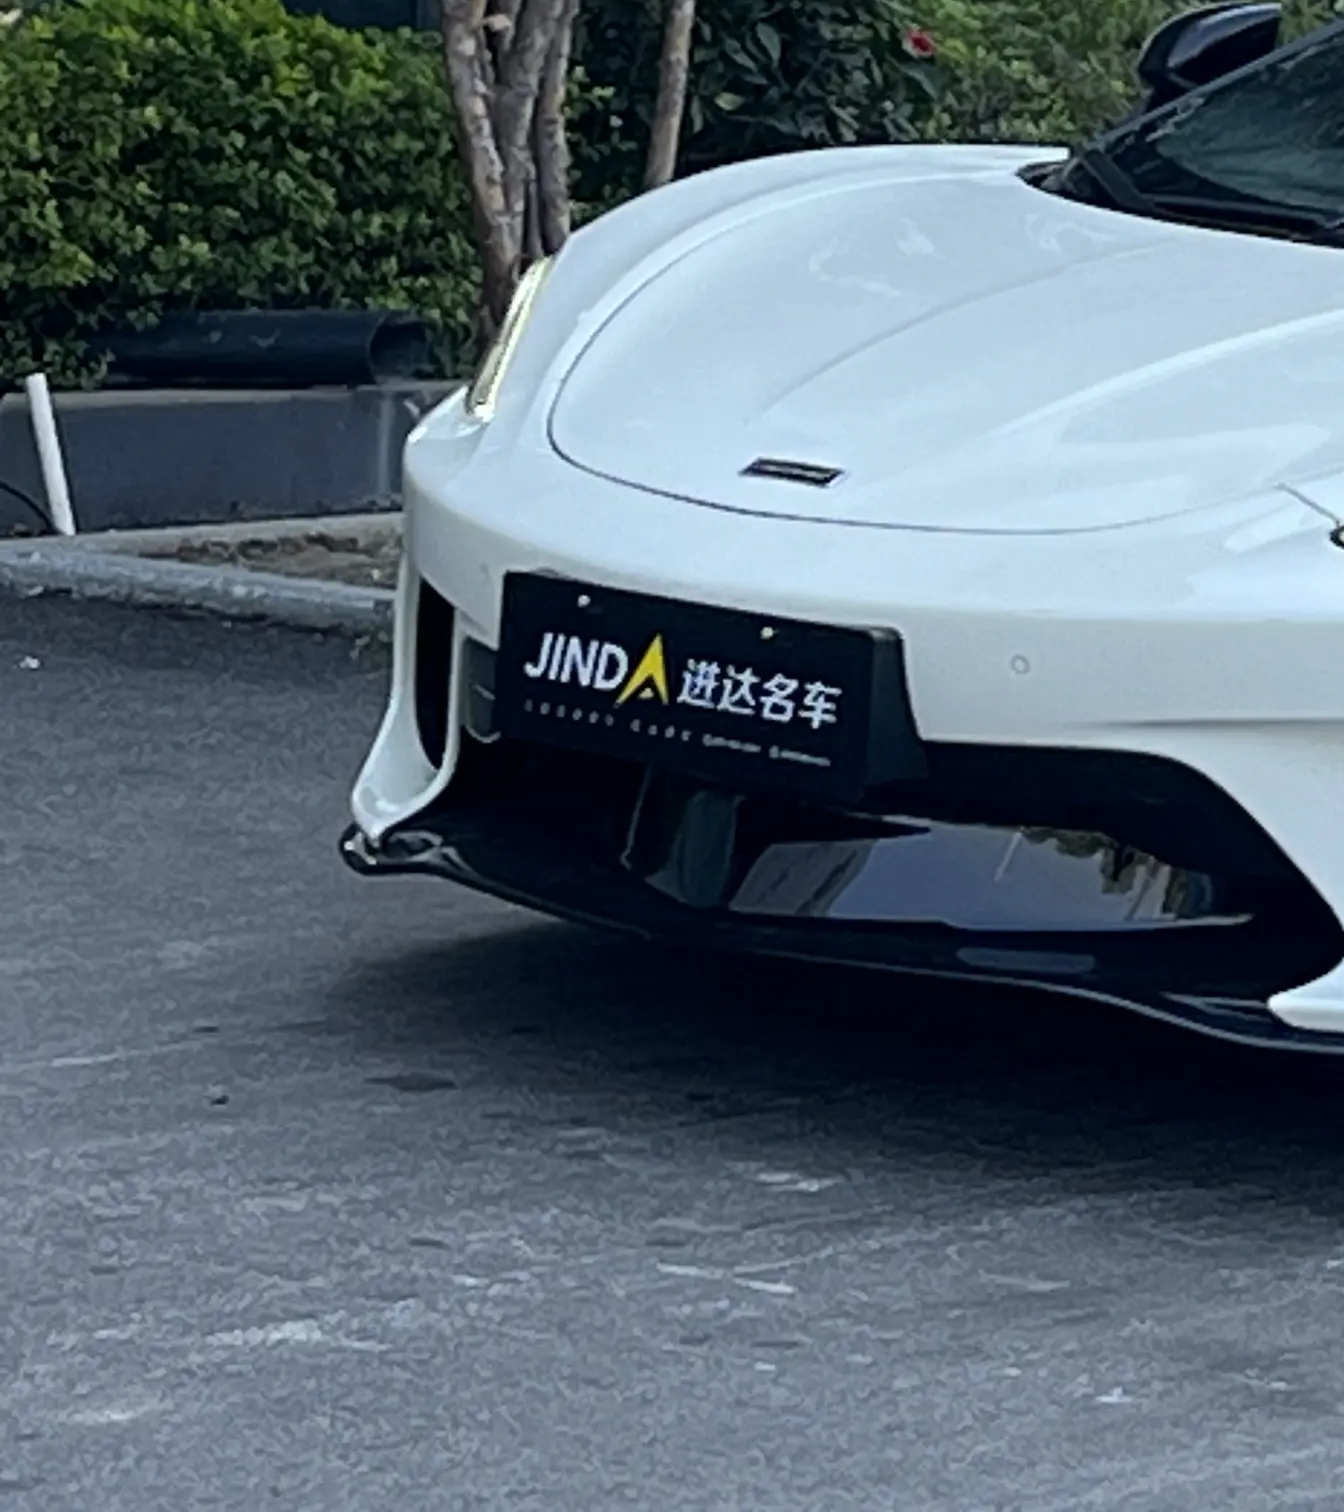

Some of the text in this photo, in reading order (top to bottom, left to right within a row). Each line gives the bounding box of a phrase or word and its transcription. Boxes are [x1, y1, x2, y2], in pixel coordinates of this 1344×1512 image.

[524, 632, 843, 730] JINDA 进达名车
